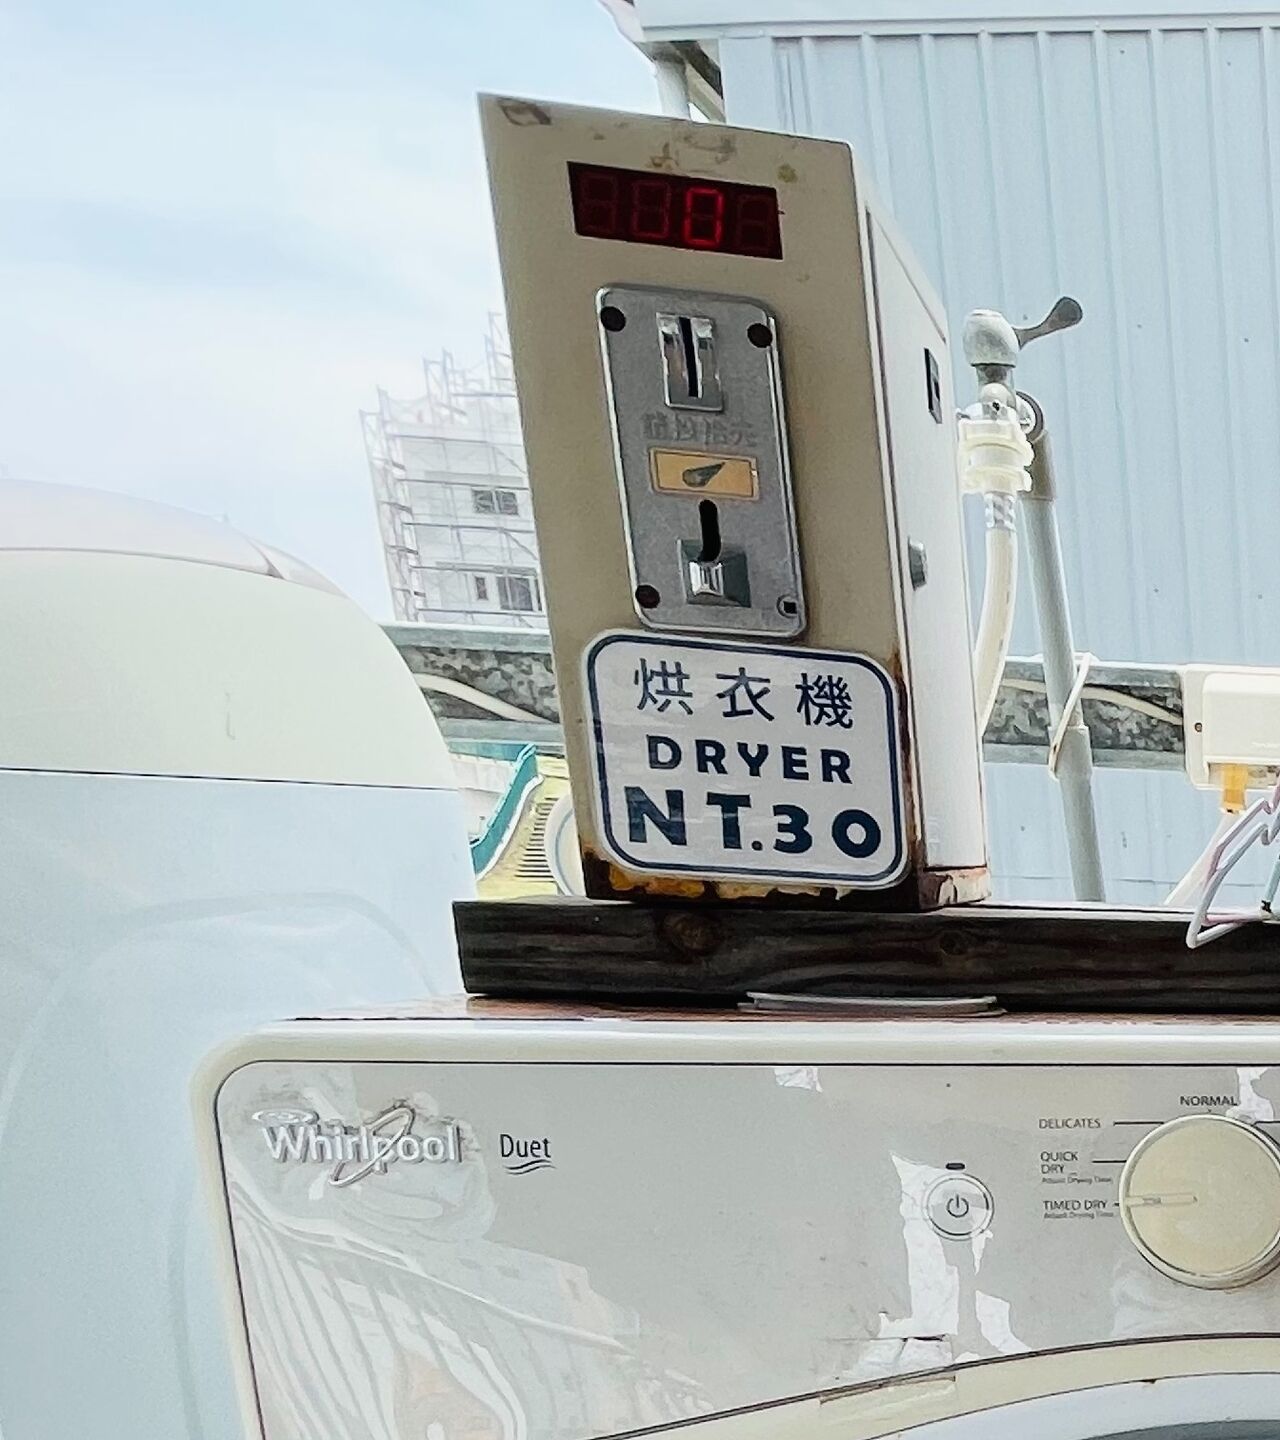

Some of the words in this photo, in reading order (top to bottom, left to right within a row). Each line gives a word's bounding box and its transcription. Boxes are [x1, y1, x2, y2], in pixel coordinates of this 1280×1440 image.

[634, 658, 853, 728] 烘衣機
[646, 734, 853, 784] DRYER
[624, 786, 881, 858] NT.30
[1180, 1096, 1238, 1107] NORMAL
[1039, 1118, 1101, 1129] DELICATES
[262, 1123, 462, 1175] Whirlpool
[499, 1133, 552, 1159] Duet
[1040, 1151, 1078, 1162] QUICK
[1041, 1164, 1065, 1174] DRY
[1043, 1200, 1081, 1211] TIMED
[1084, 1200, 1107, 1211] DRY
